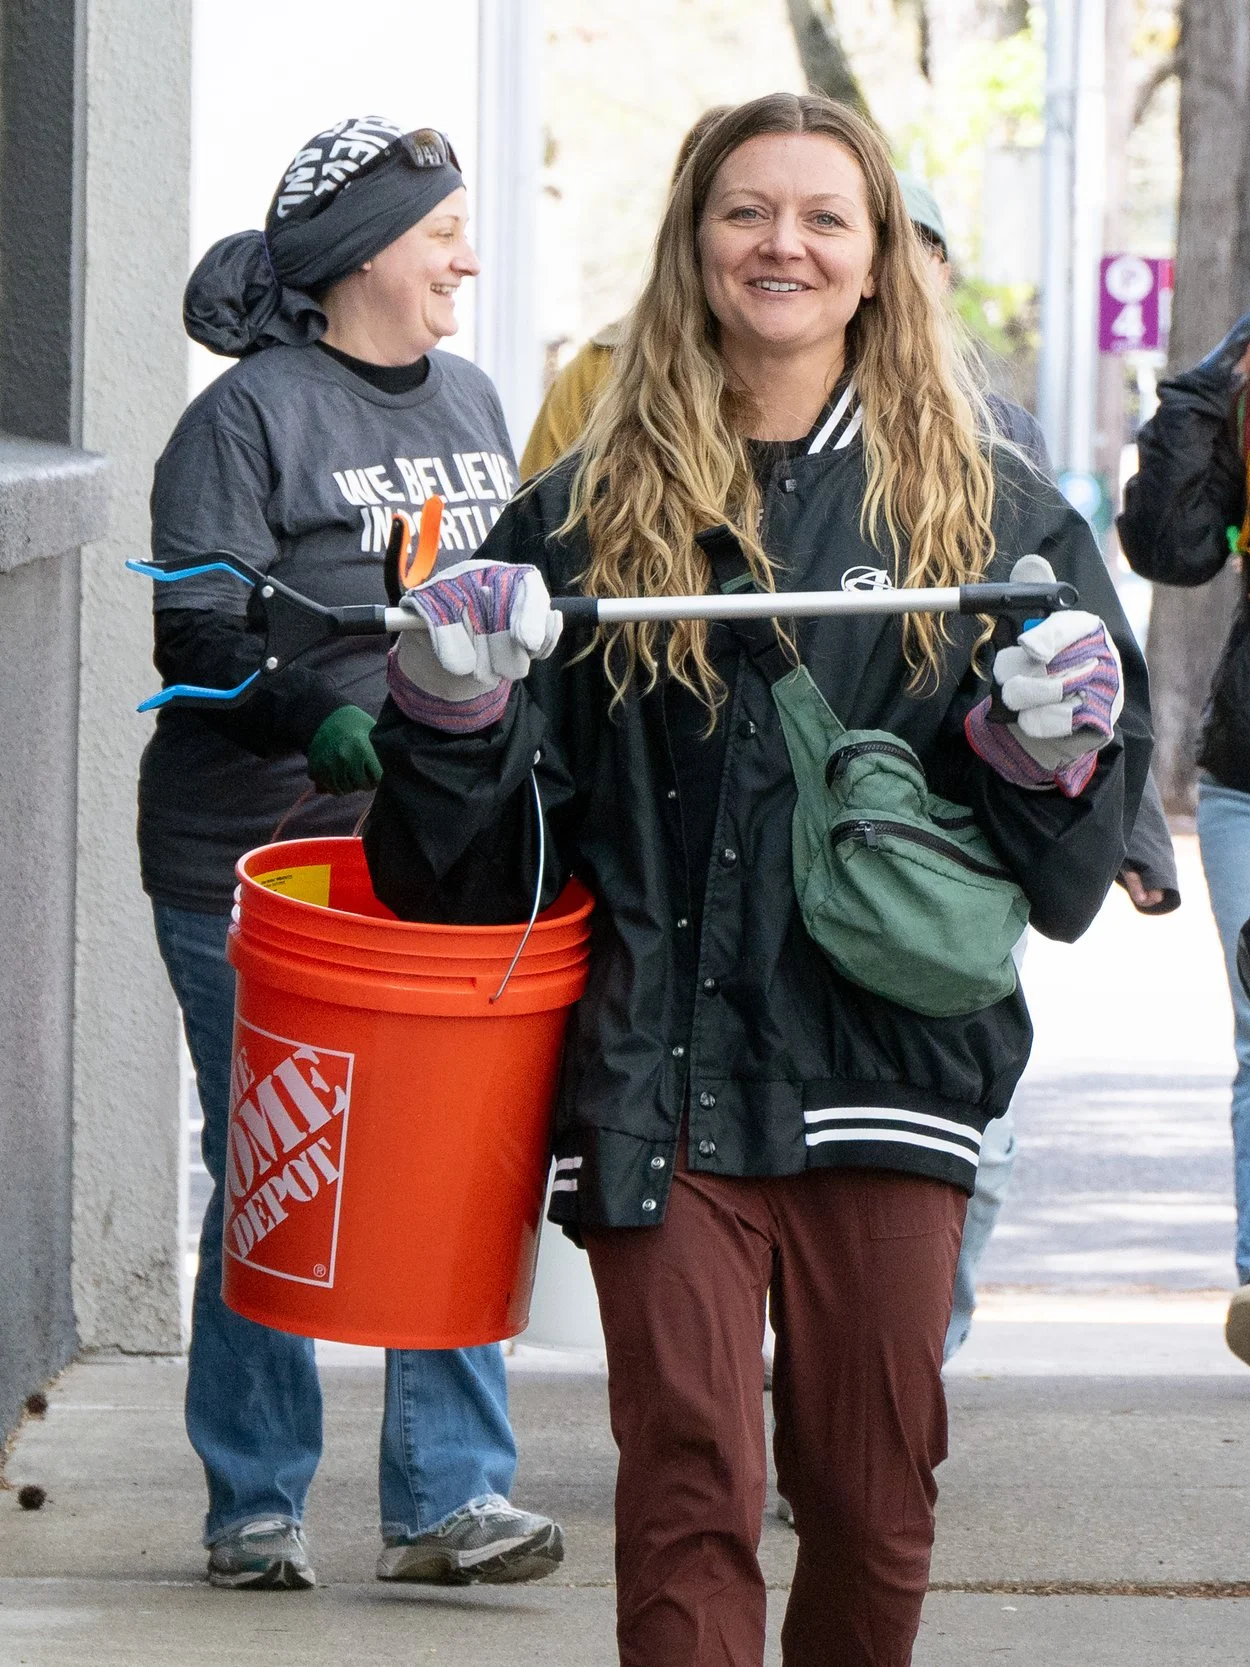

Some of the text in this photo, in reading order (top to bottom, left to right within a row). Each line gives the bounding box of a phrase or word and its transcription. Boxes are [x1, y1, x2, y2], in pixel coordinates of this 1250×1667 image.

[1111, 303, 1147, 340] 4
[333, 464, 406, 506] WE
[360, 506, 393, 553] IN
[226, 1046, 347, 1200] OME
[231, 1137, 340, 1260] DEPOT
